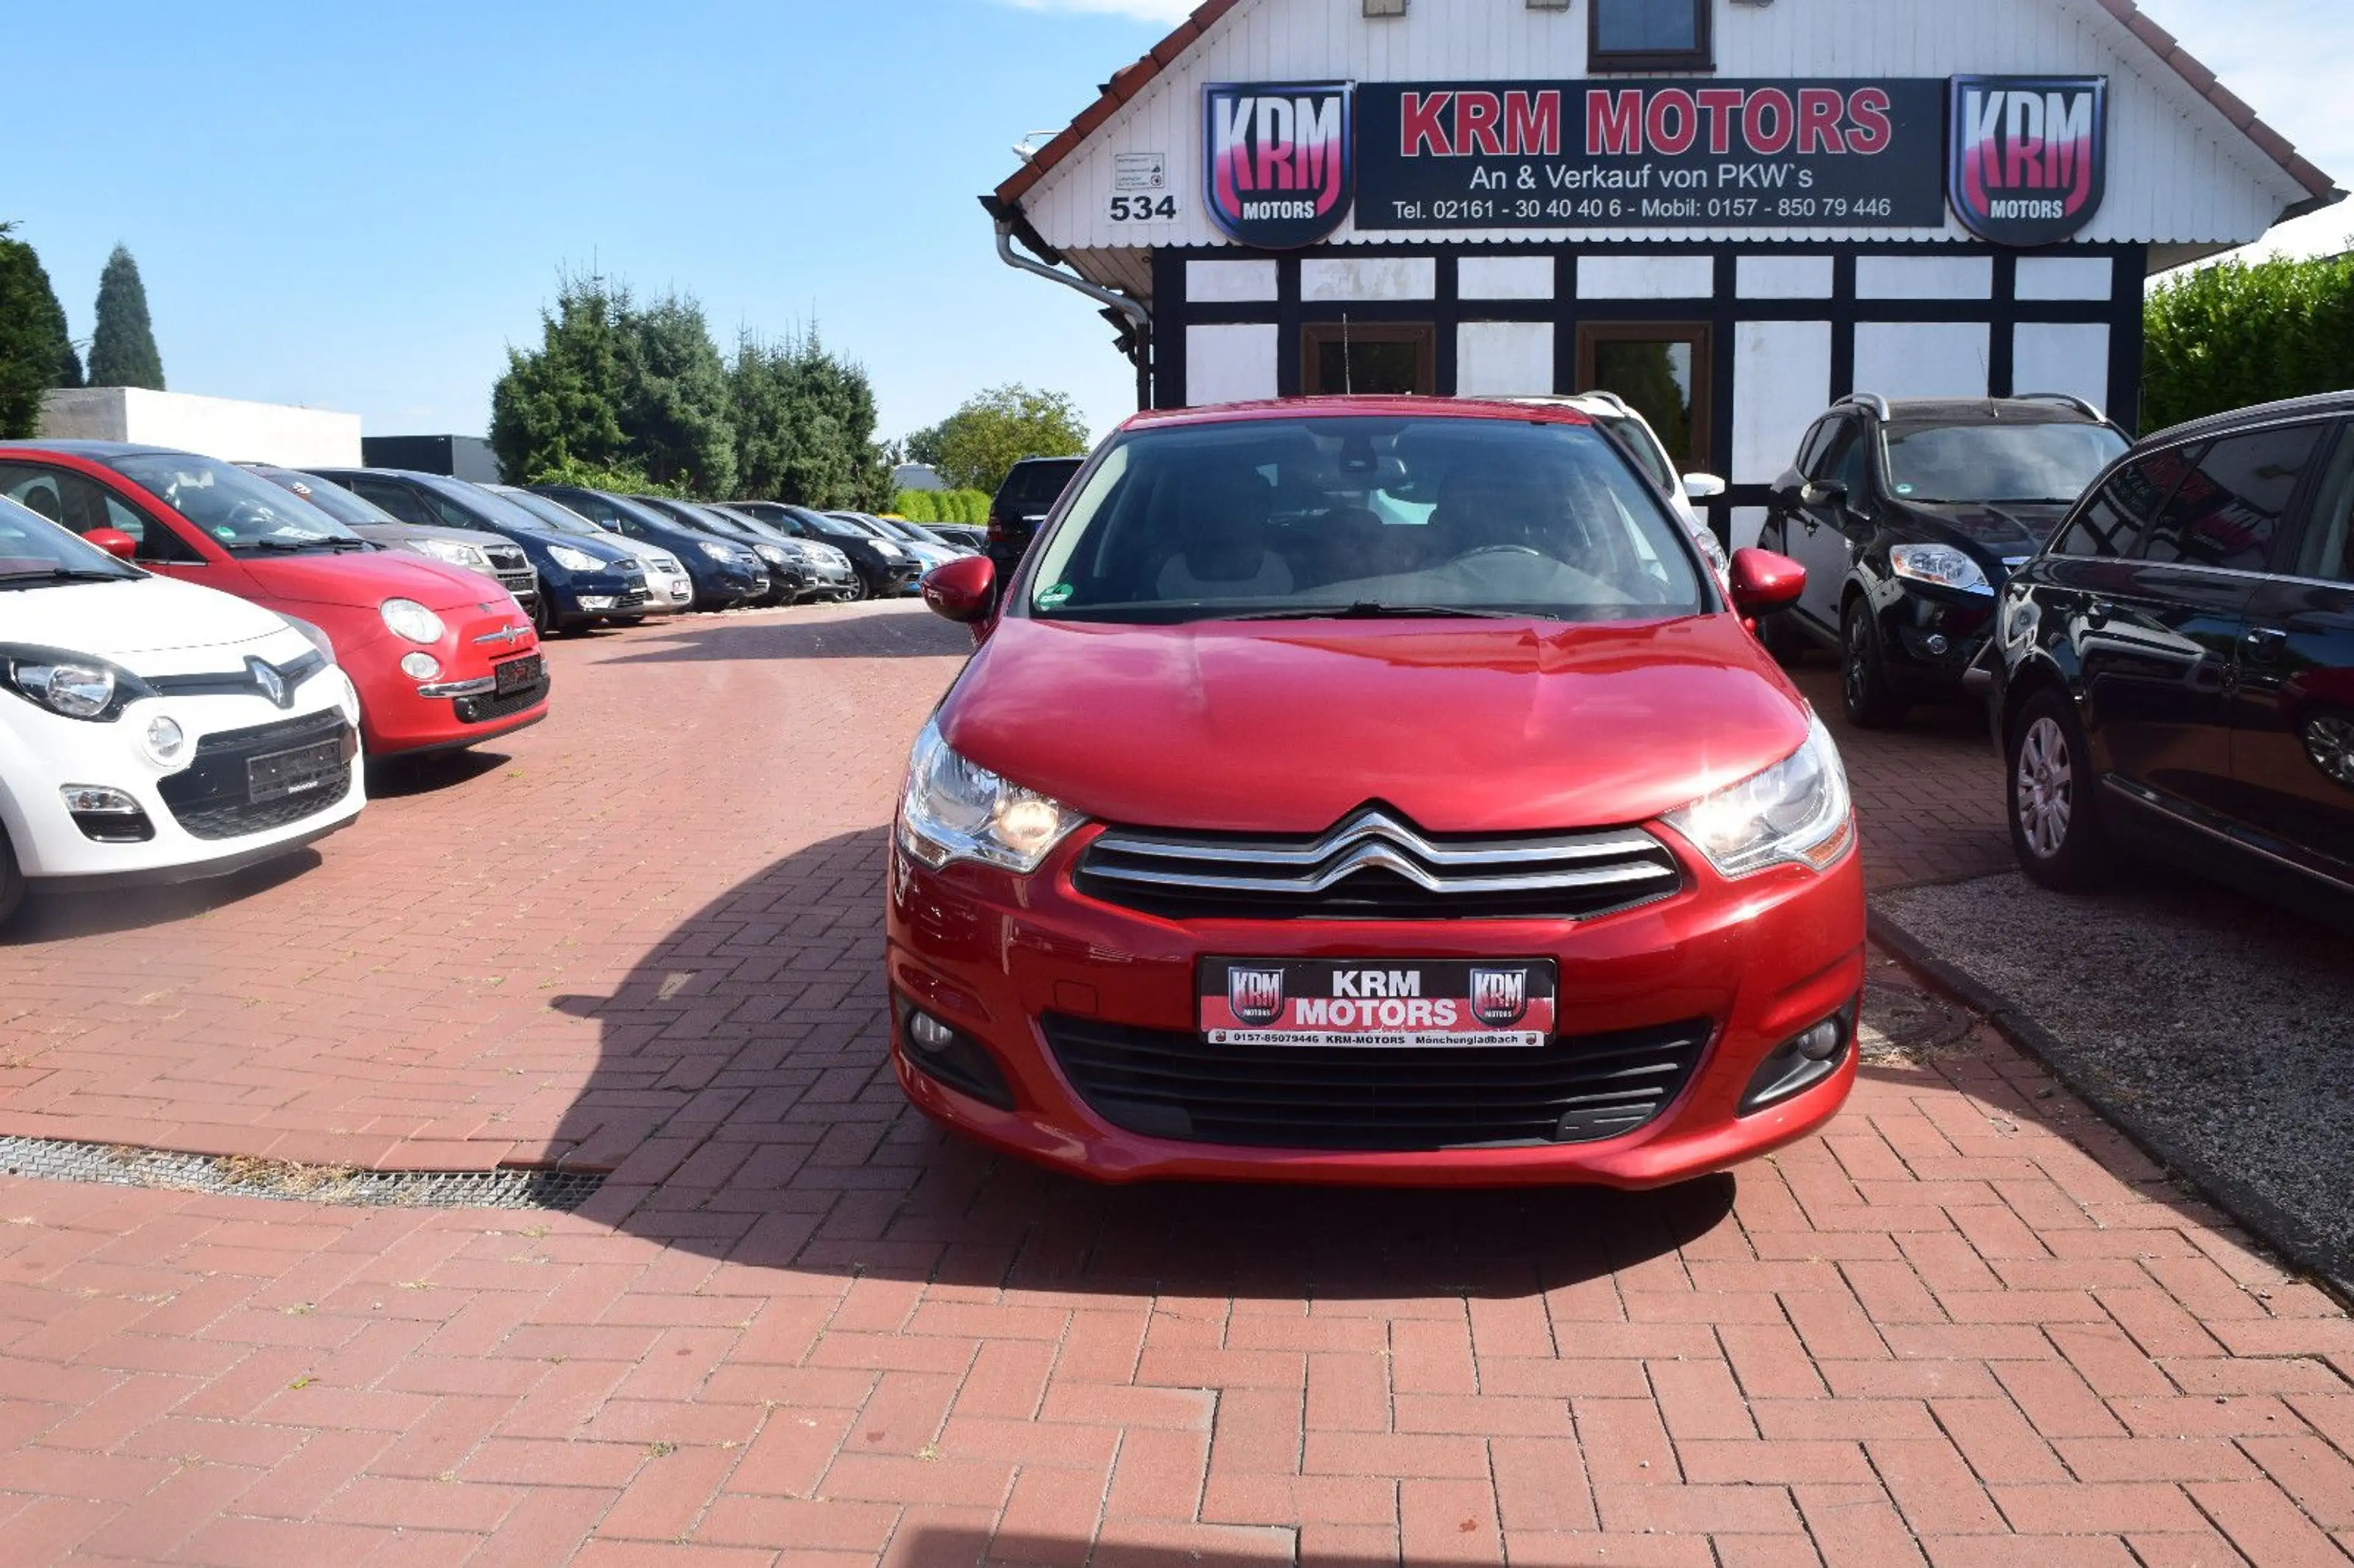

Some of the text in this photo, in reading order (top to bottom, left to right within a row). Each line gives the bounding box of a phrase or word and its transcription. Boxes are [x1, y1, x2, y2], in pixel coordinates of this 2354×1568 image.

[1400, 88, 1891, 157] KRM MOTORS
[1215, 97, 1341, 191] KRM
[1964, 90, 2092, 189] KRM
[1469, 166, 1506, 189] An
[1517, 165, 1536, 189] &
[1545, 164, 1651, 188] Verkauf
[1659, 170, 1707, 188] von
[1110, 196, 1176, 221] 534
[1243, 200, 1315, 219] MOTORS
[1392, 201, 1426, 219] Tel.
[1433, 200, 1493, 219] 02161
[1515, 200, 1540, 218] 30
[1546, 199, 1571, 217] 40
[1577, 199, 1602, 217] 40
[1609, 199, 1621, 217] 6
[1642, 199, 1701, 217] Mobil:
[1708, 198, 1758, 216] 0157
[1778, 198, 1815, 216] 850
[1823, 198, 1846, 216] 79
[1853, 198, 1891, 216] 446
[1990, 199, 2063, 219] MOTORS
[1233, 972, 1279, 1007] KRM
[1333, 970, 1420, 997] KRM
[1474, 973, 1522, 1007] KRM
[1296, 998, 1457, 1026] MOTORS
[1326, 1035, 1406, 1045] KRM-MOTORS
[1415, 1035, 1518, 1045] Mönchengladbach
